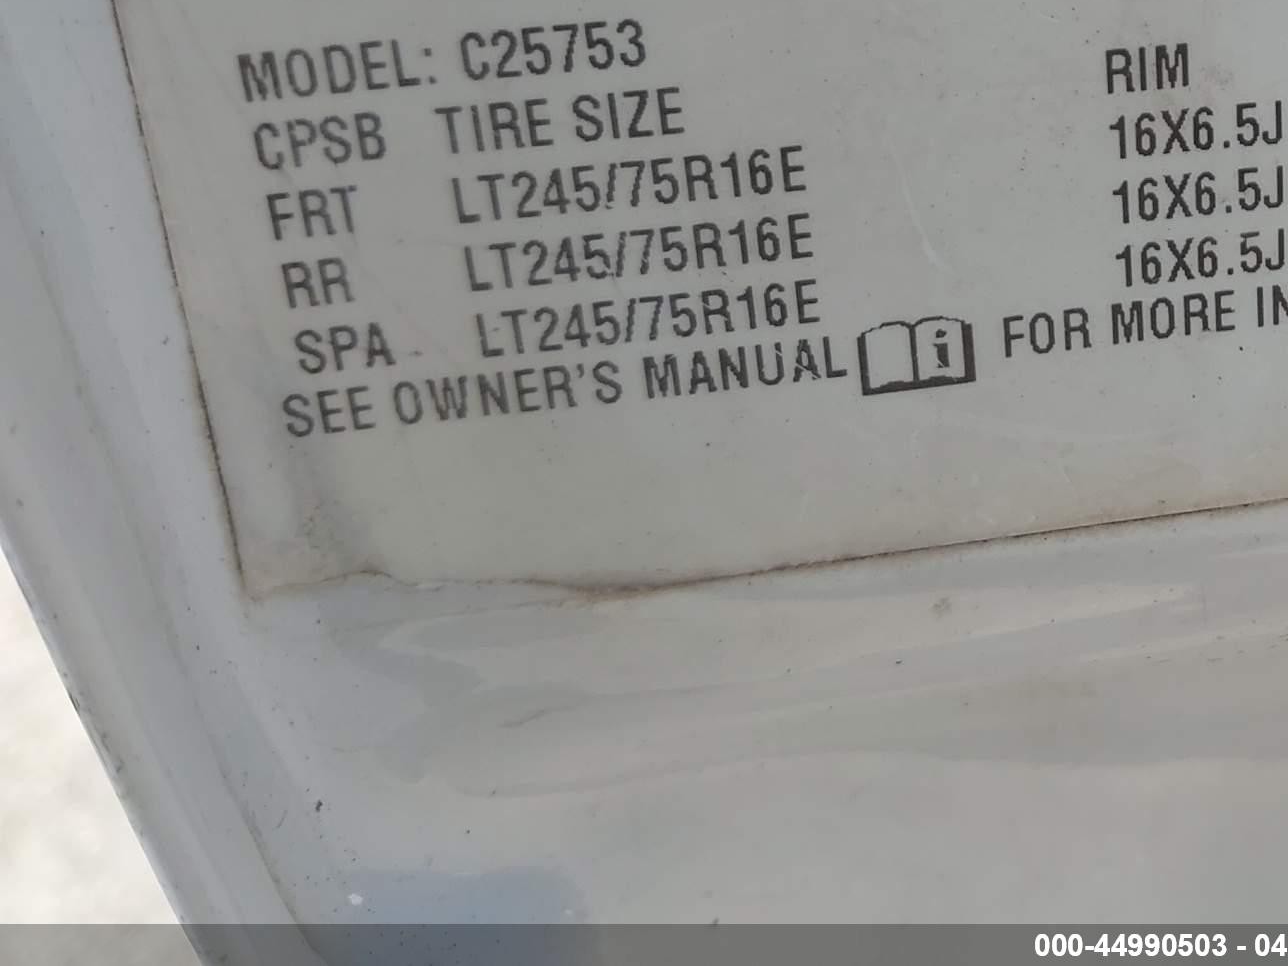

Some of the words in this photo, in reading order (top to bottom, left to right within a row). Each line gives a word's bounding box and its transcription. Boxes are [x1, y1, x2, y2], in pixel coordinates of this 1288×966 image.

[238, 40, 435, 102] MODEL:
[460, 19, 645, 80] C25753
[1106, 43, 1189, 94] RIM
[254, 113, 386, 170] CPSB
[435, 99, 553, 153] TIRE
[573, 87, 684, 142] SIZE
[1109, 100, 1282, 159] 16X6.5J
[266, 186, 356, 240] FRT
[452, 145, 806, 223] LT245/75R16E
[1112, 166, 1283, 224] 16X6.5J
[464, 213, 813, 291] LT245/75R16E
[1116, 229, 1285, 287] 16X6.5J
[281, 259, 351, 308] RR
[295, 323, 395, 374] SPA
[477, 279, 820, 360] LT245/75R16E
[283, 387, 374, 437] SEE
[394, 362, 622, 424] OWNER'S
[643, 337, 847, 399] MANUAL
[1003, 308, 1091, 358] FOR
[1111, 290, 1235, 345] MORE
